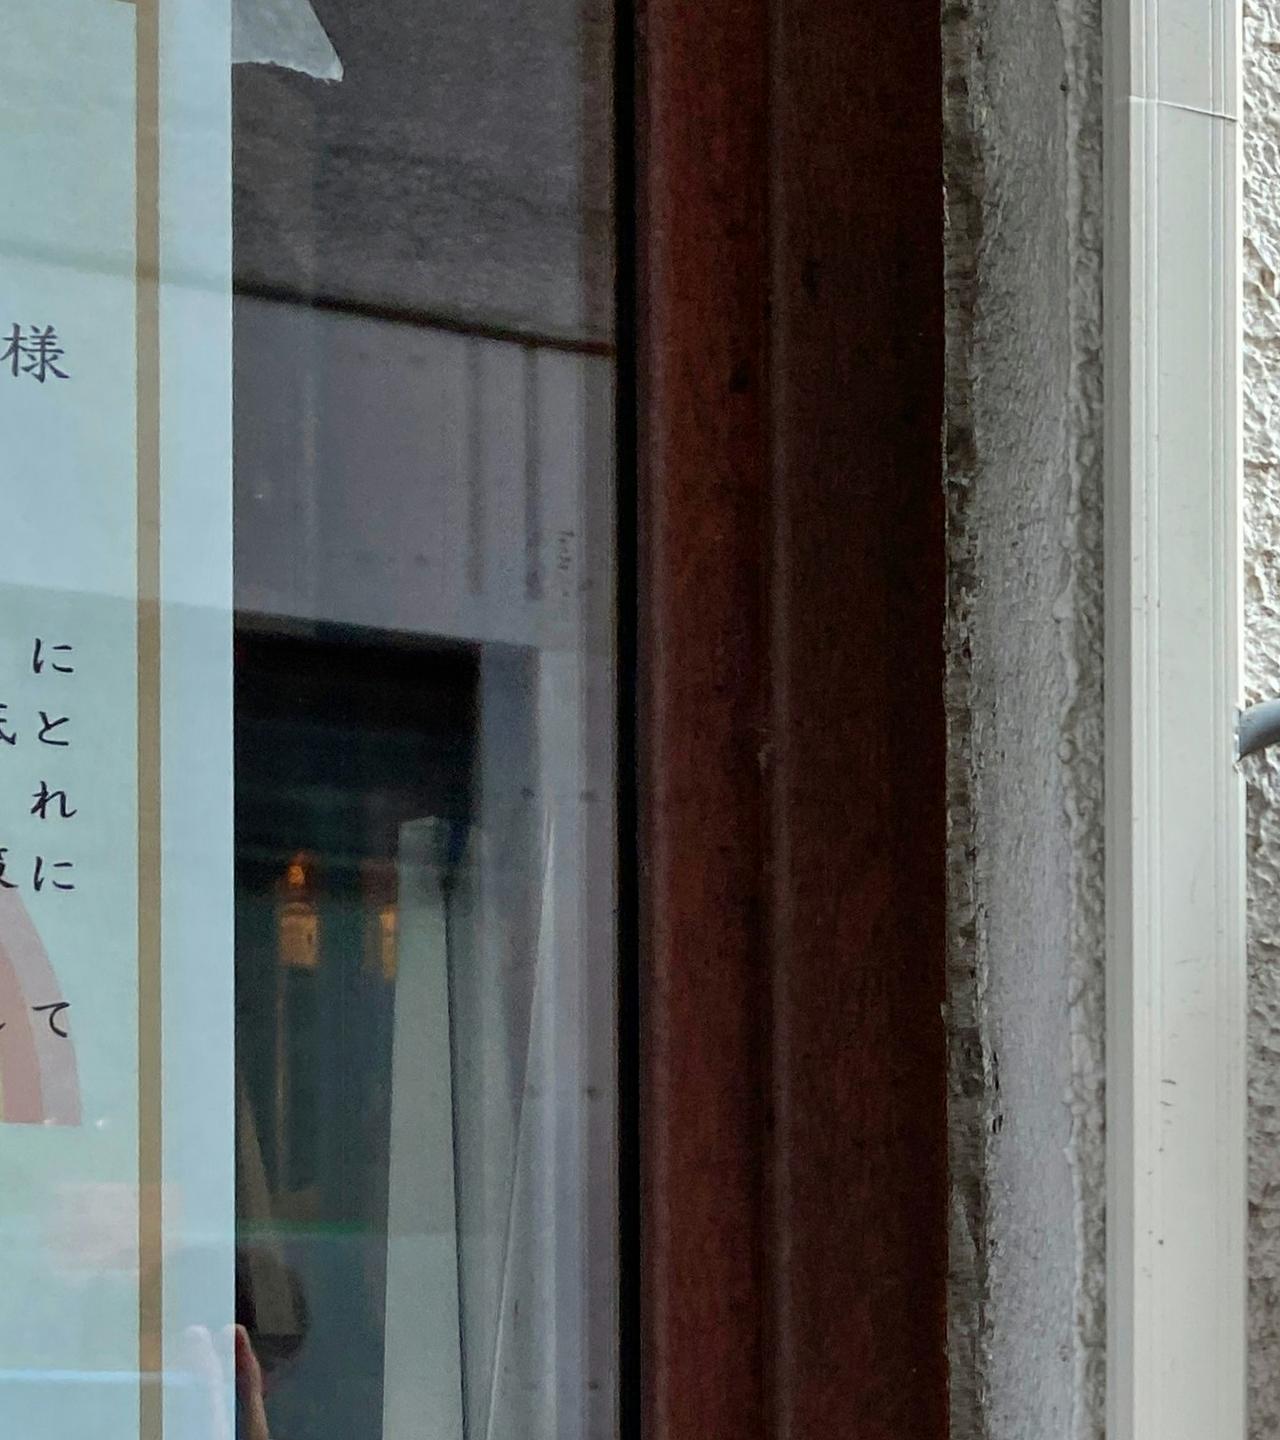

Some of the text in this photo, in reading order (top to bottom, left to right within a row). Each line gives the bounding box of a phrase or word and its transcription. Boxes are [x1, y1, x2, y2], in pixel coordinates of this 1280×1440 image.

[1, 323, 70, 381] 様
[32, 637, 74, 673] に
[30, 781, 77, 819] れ
